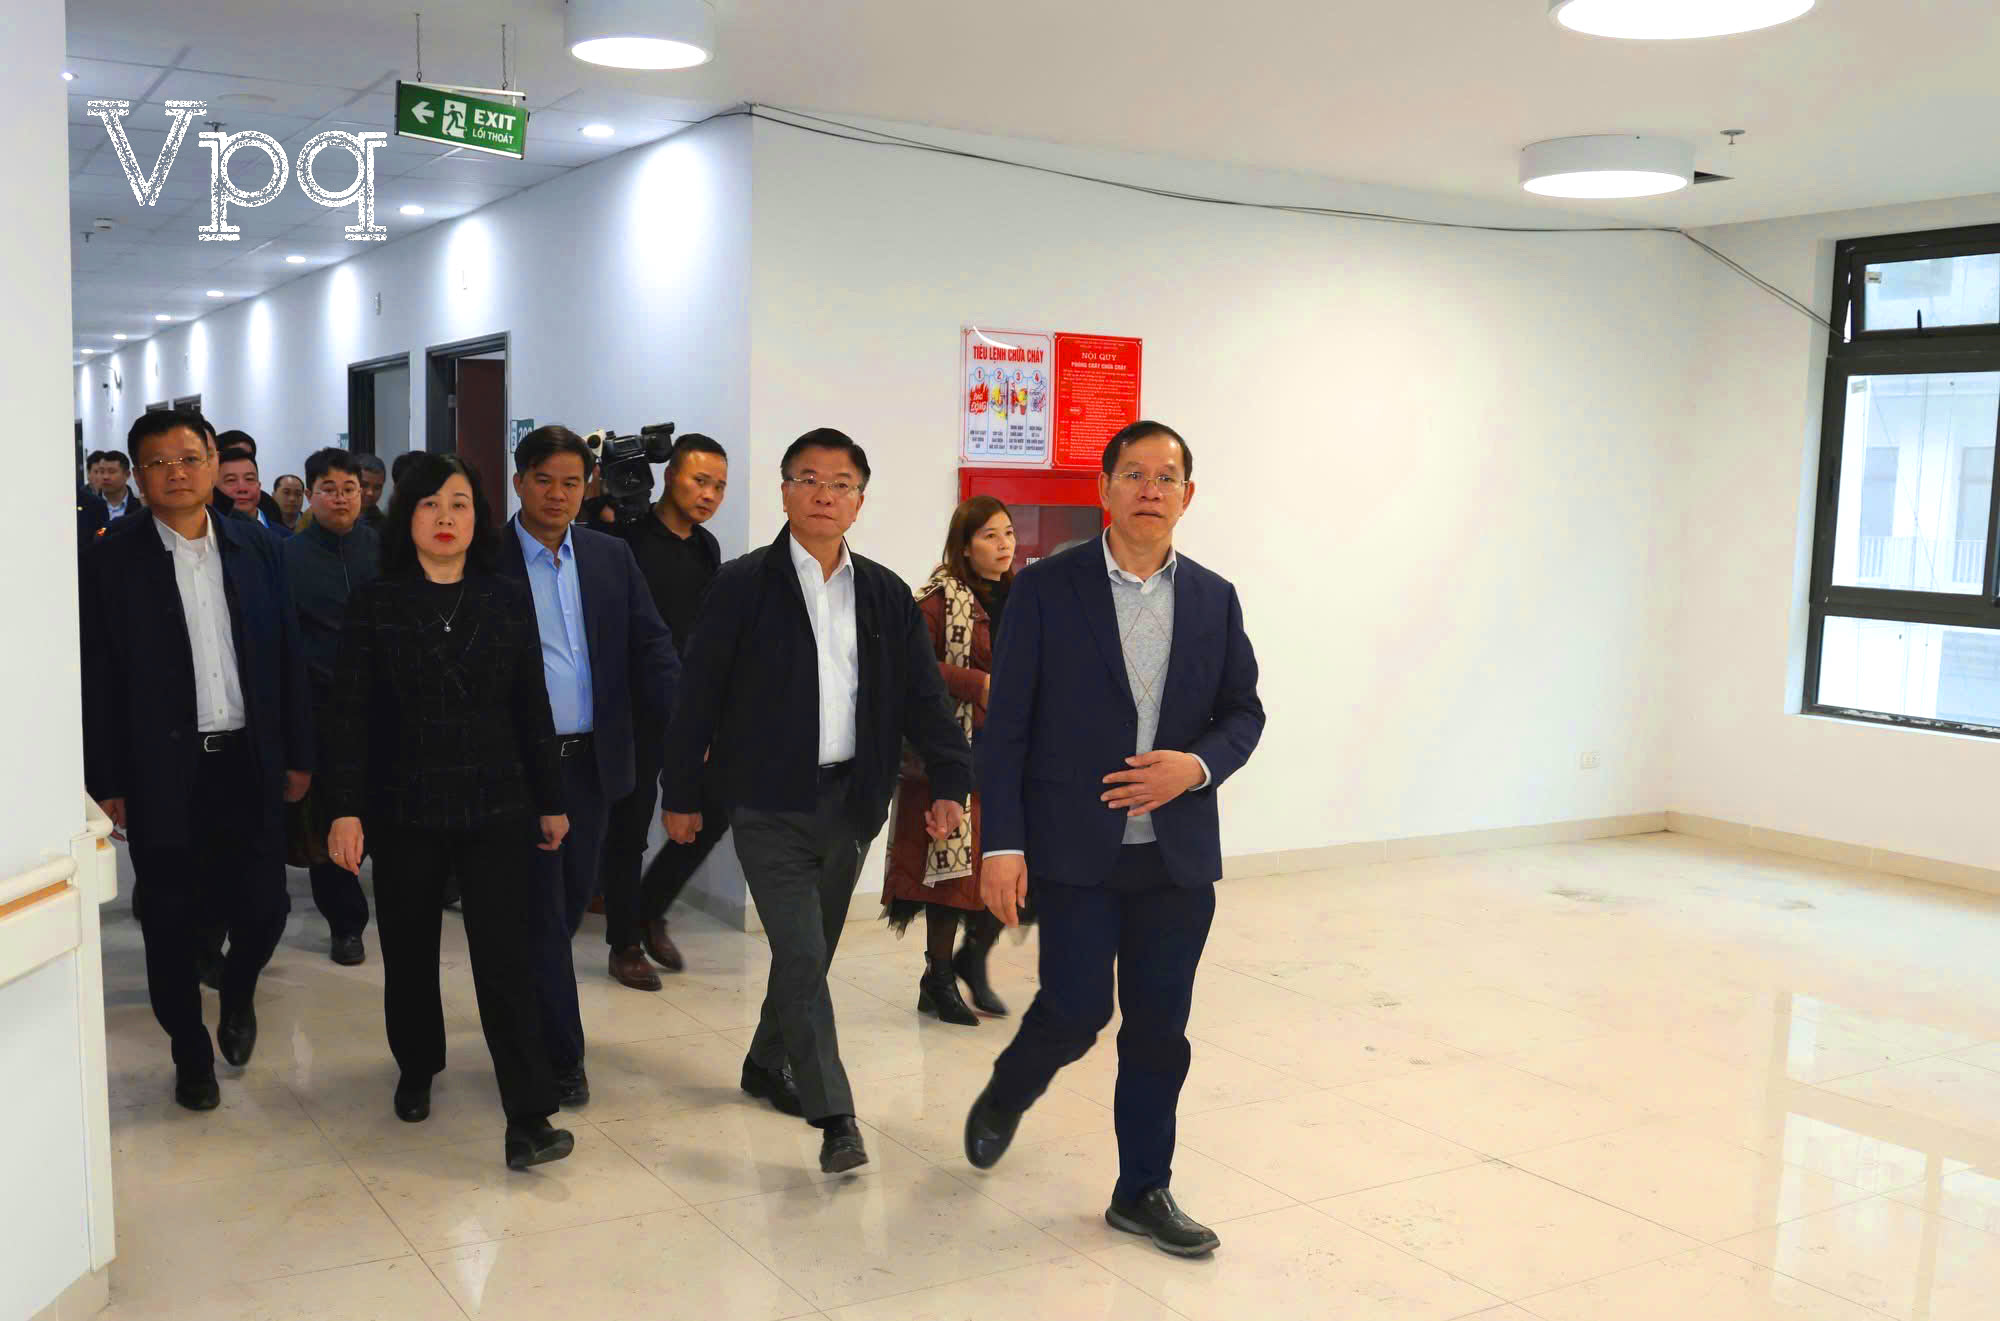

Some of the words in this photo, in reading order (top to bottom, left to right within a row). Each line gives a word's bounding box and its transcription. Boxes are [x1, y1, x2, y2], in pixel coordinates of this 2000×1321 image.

[474, 109, 516, 131] EXIT
[472, 127, 486, 139] LỐI
[487, 131, 514, 145] THOÁT
[1027, 347, 1044, 363] CHÁY
[1099, 353, 1117, 362] QUY
[996, 370, 1002, 379] 2
[1015, 372, 1021, 381] 3
[1034, 373, 1040, 382] 4
[951, 625, 966, 644] H
[935, 850, 950, 869] H
